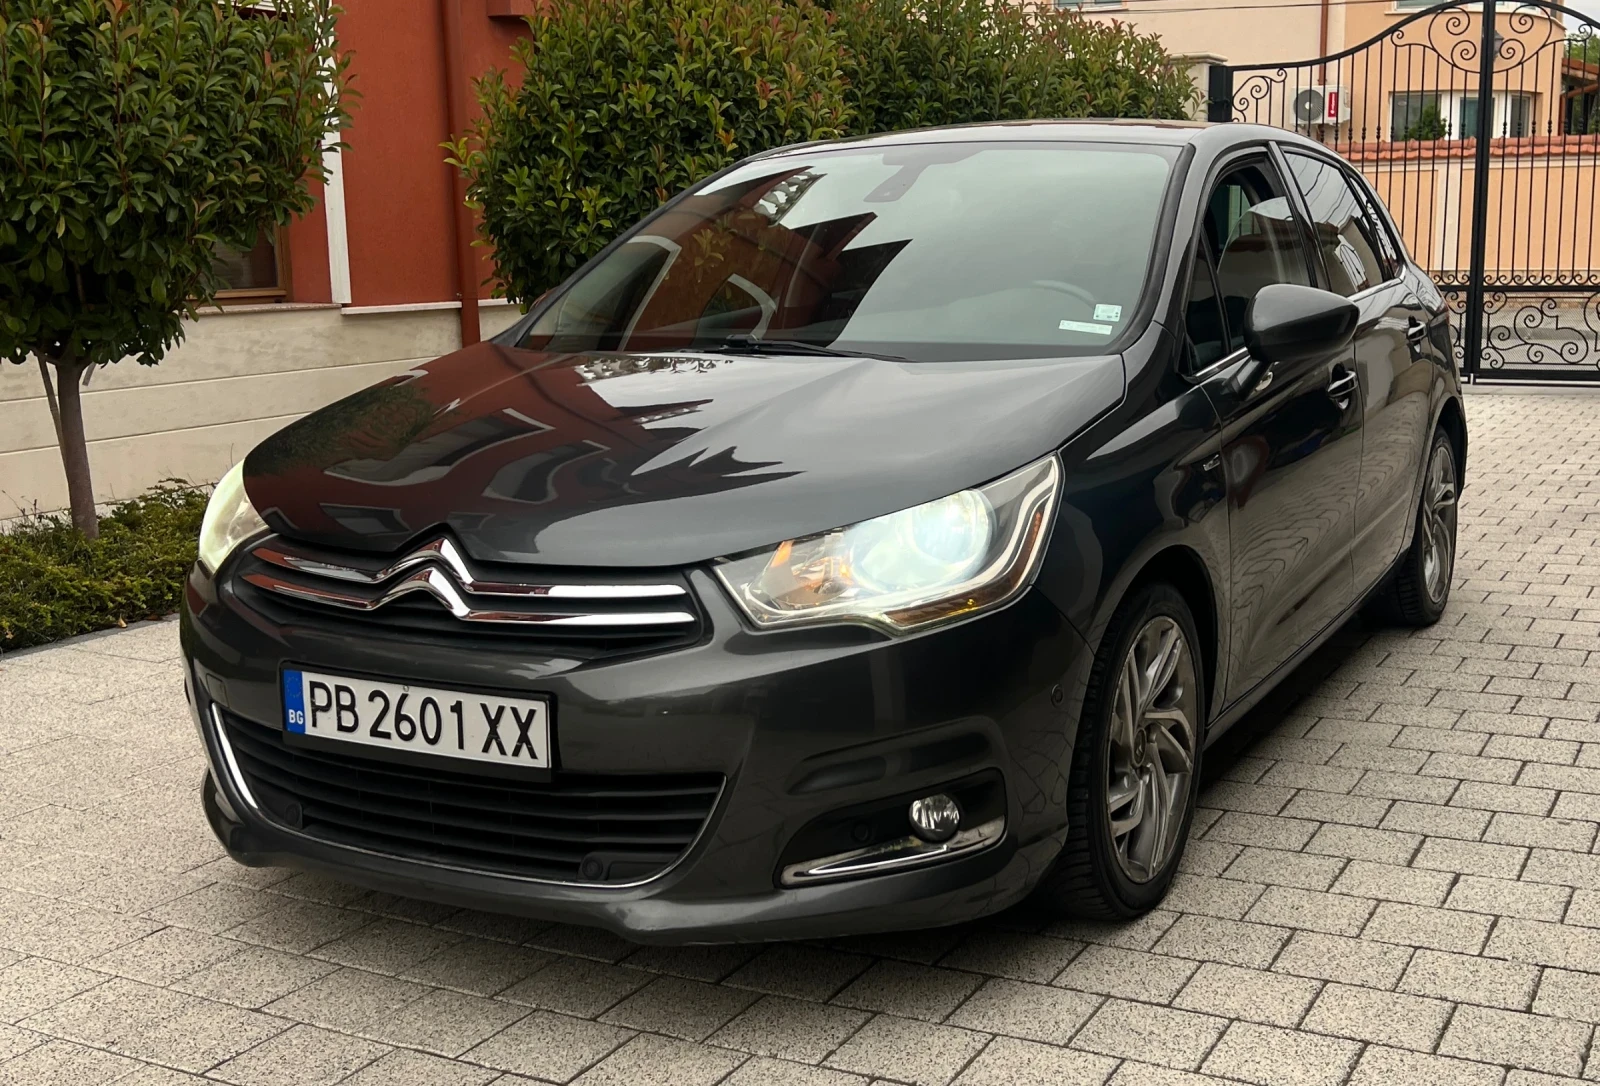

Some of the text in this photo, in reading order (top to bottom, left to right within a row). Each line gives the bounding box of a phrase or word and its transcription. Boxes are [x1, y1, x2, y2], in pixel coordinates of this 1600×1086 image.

[288, 710, 304, 725] BG
[309, 680, 539, 760] PB 2601 XX
